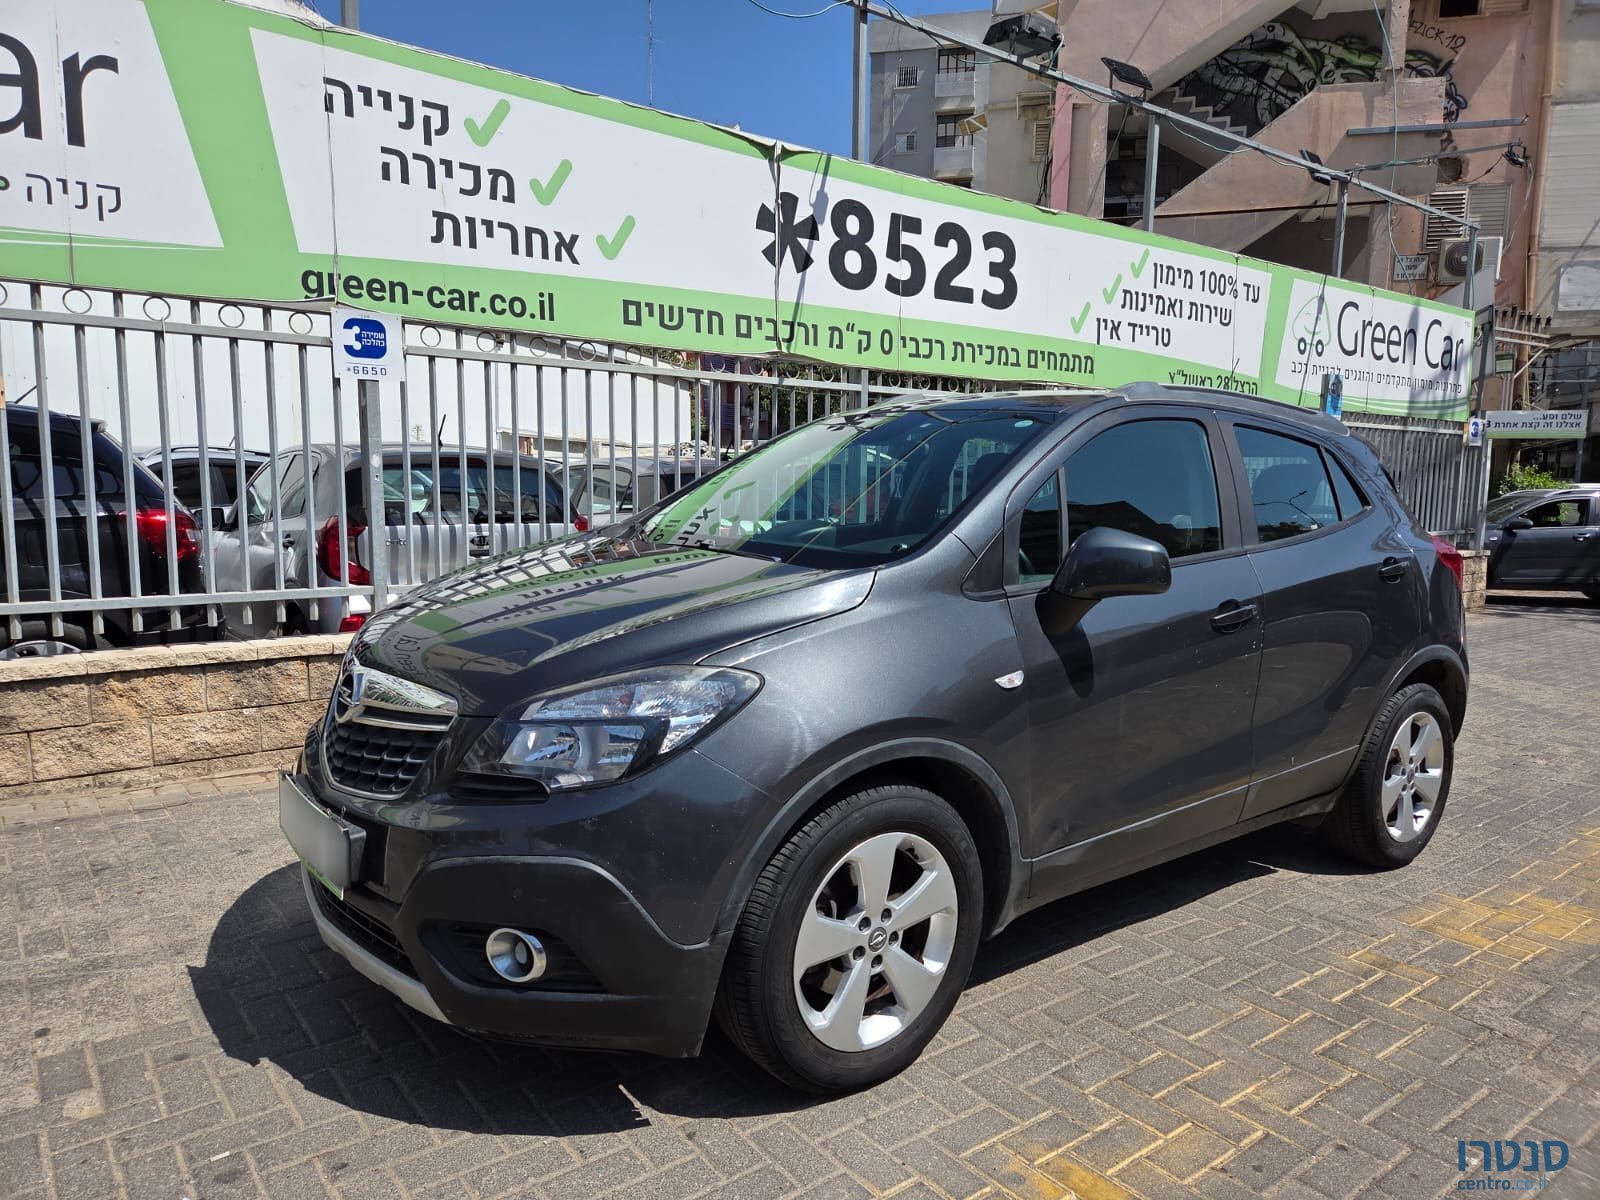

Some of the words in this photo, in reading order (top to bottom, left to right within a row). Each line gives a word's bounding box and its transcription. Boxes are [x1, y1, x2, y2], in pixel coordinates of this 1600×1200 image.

[322, 75, 450, 147] קנייה
[380, 145, 516, 204] מכירה
[24, 172, 122, 222] קניה
[430, 209, 580, 266] אחריות
[1152, 262, 1194, 290] מימון
[1199, 269, 1239, 300] 100%
[301, 268, 556, 322] green-car.co.il
[1120, 288, 1184, 319] ואמינות
[1242, 282, 1261, 304] עד
[622, 298, 724, 336] חדשים
[1187, 300, 1233, 327] שירות
[735, 313, 819, 347] ורכבים
[1096, 317, 1122, 345] אין
[1127, 321, 1171, 348] טרייד
[1337, 300, 1418, 366] Green
[1424, 318, 1464, 372] Car
[900, 334, 945, 361] רכבי
[951, 340, 1022, 368] במכירת
[1026, 348, 1095, 375] מתמחים
